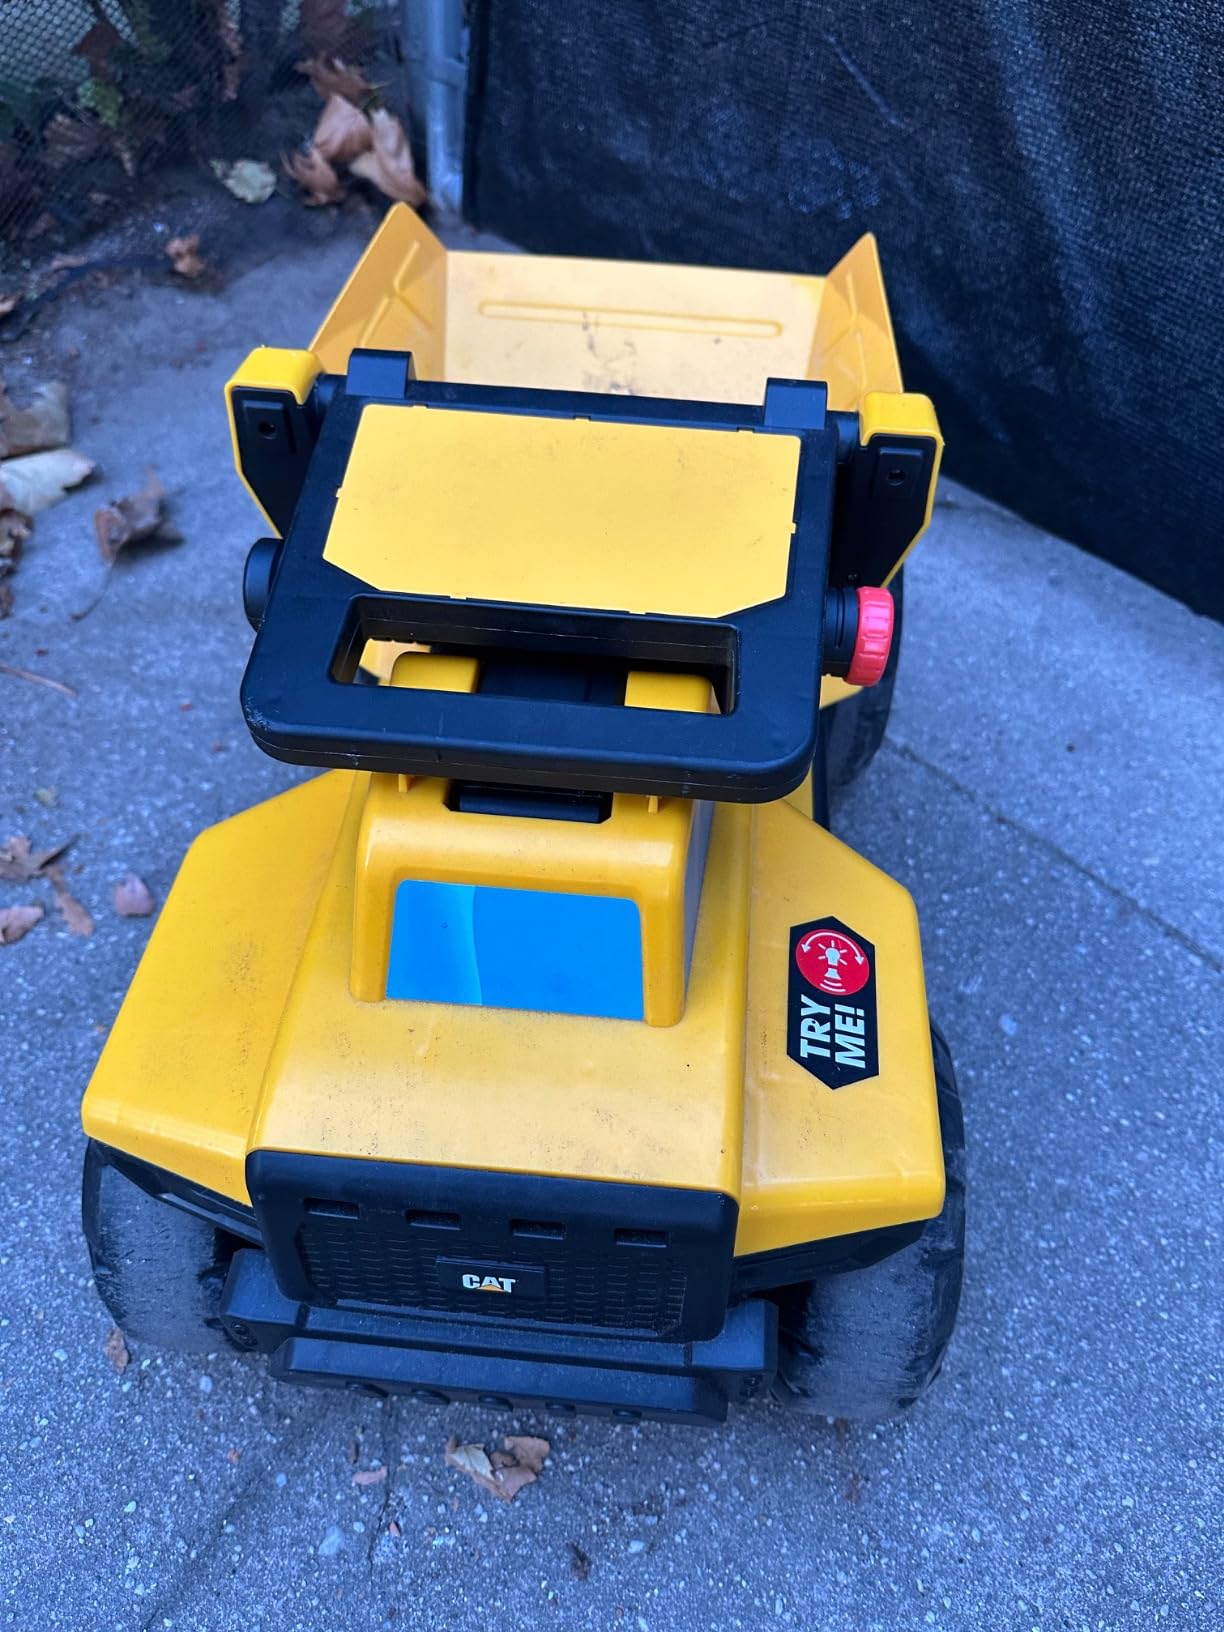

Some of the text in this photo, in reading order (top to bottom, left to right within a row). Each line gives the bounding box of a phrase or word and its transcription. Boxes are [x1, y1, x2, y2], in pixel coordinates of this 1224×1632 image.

[800, 993, 831, 1058] TRY
[834, 1003, 866, 1069] ME!
[462, 1273, 516, 1293] CAT
